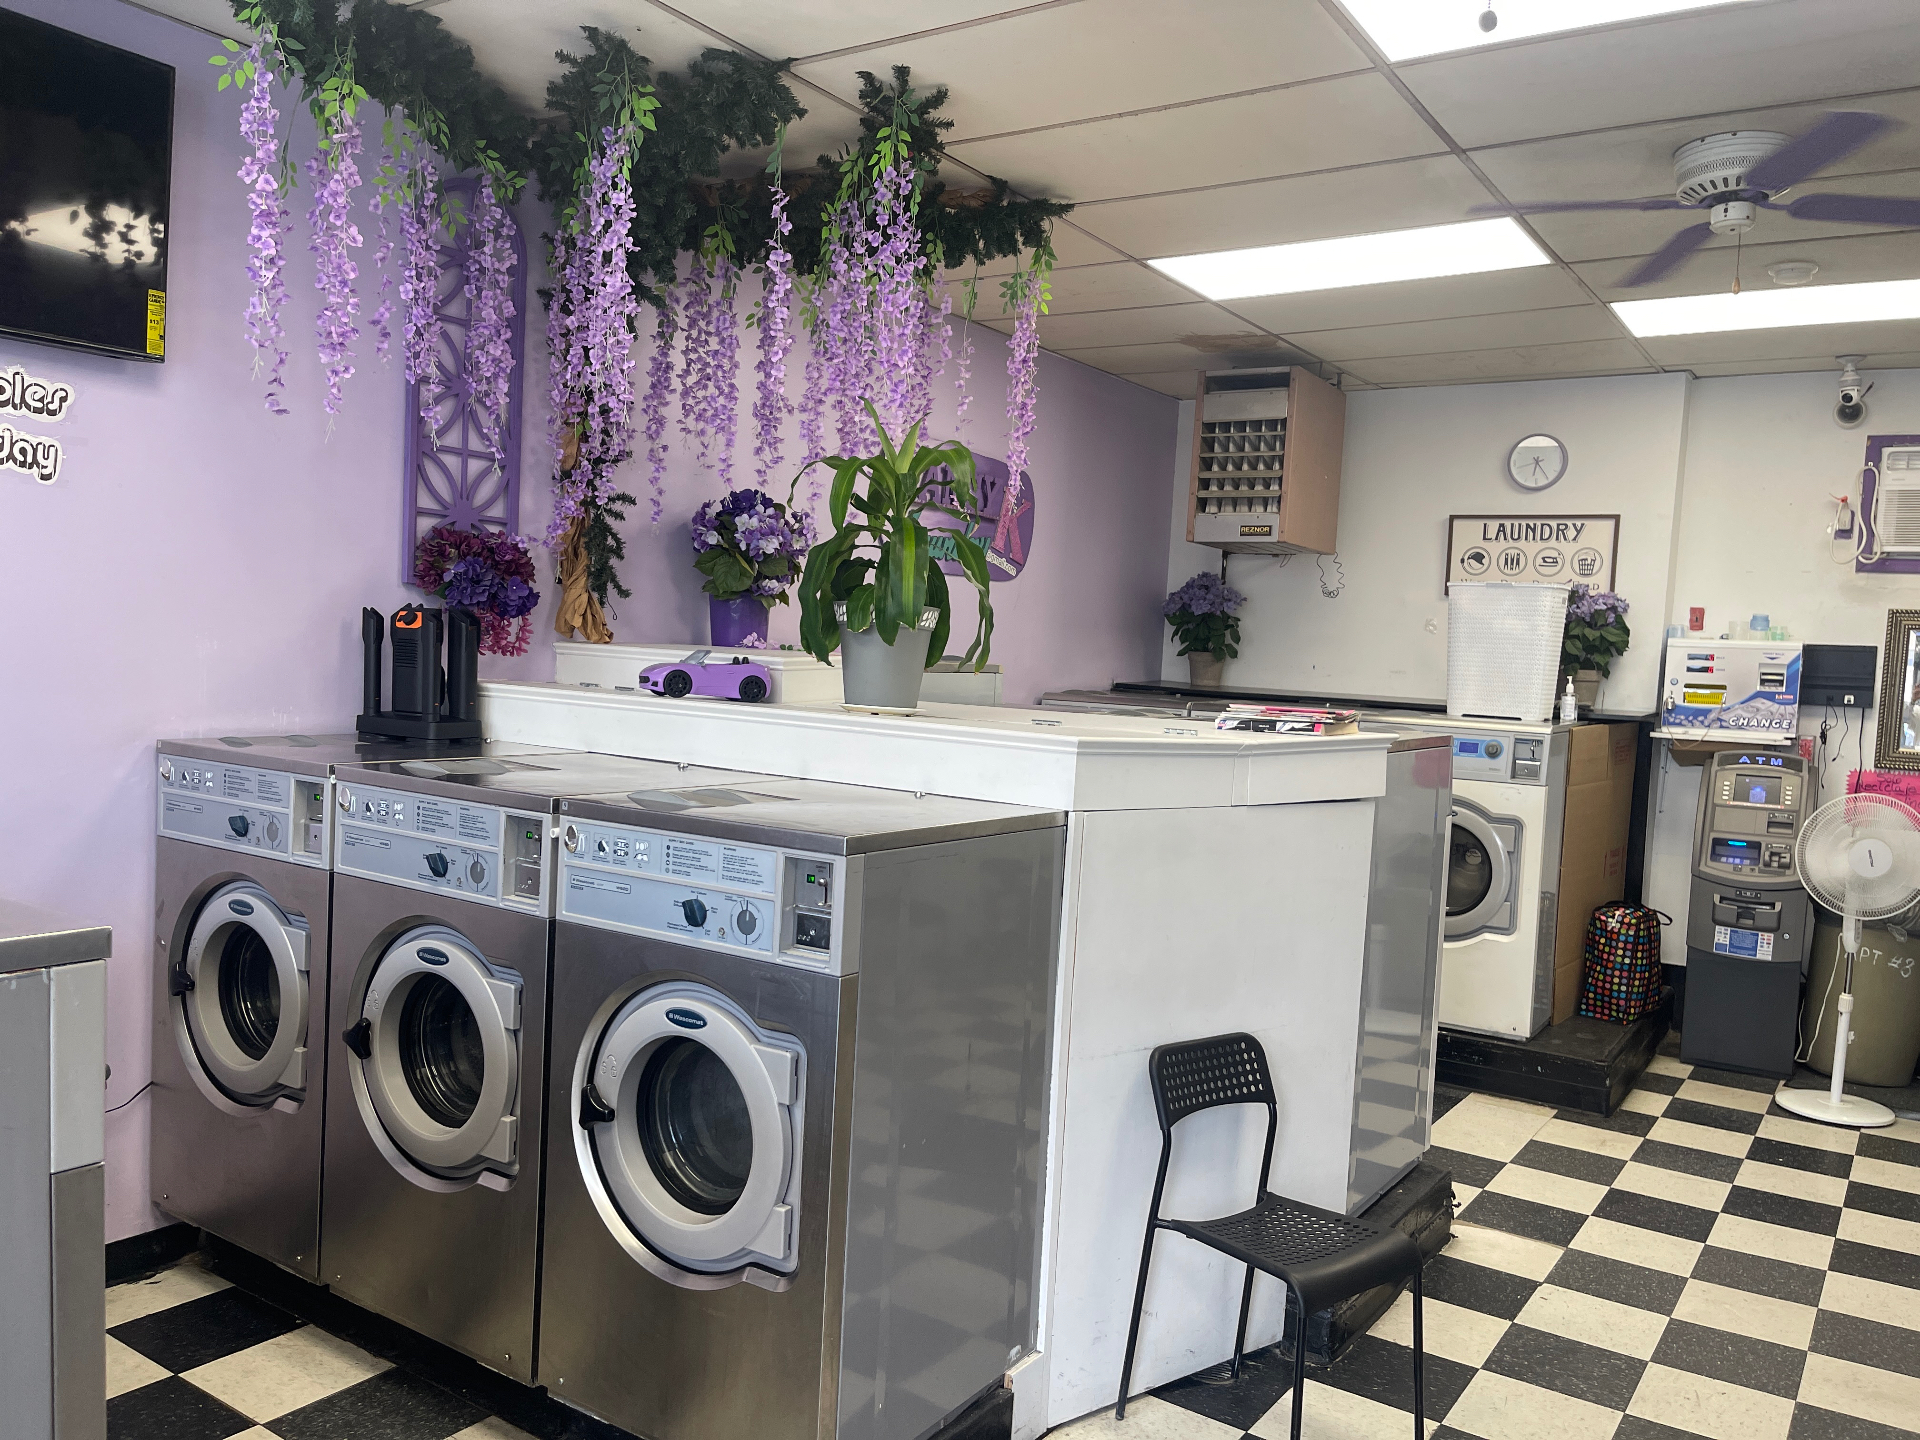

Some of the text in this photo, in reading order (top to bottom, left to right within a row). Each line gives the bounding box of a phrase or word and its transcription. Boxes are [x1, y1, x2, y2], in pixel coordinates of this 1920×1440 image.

[1240, 526, 1271, 534] REZNOR
[1482, 522, 1586, 543] LAUNDRY
[1729, 717, 1791, 729] CHANGE
[1739, 755, 1783, 766] ATM
[673, 1013, 704, 1026] Wascomat
